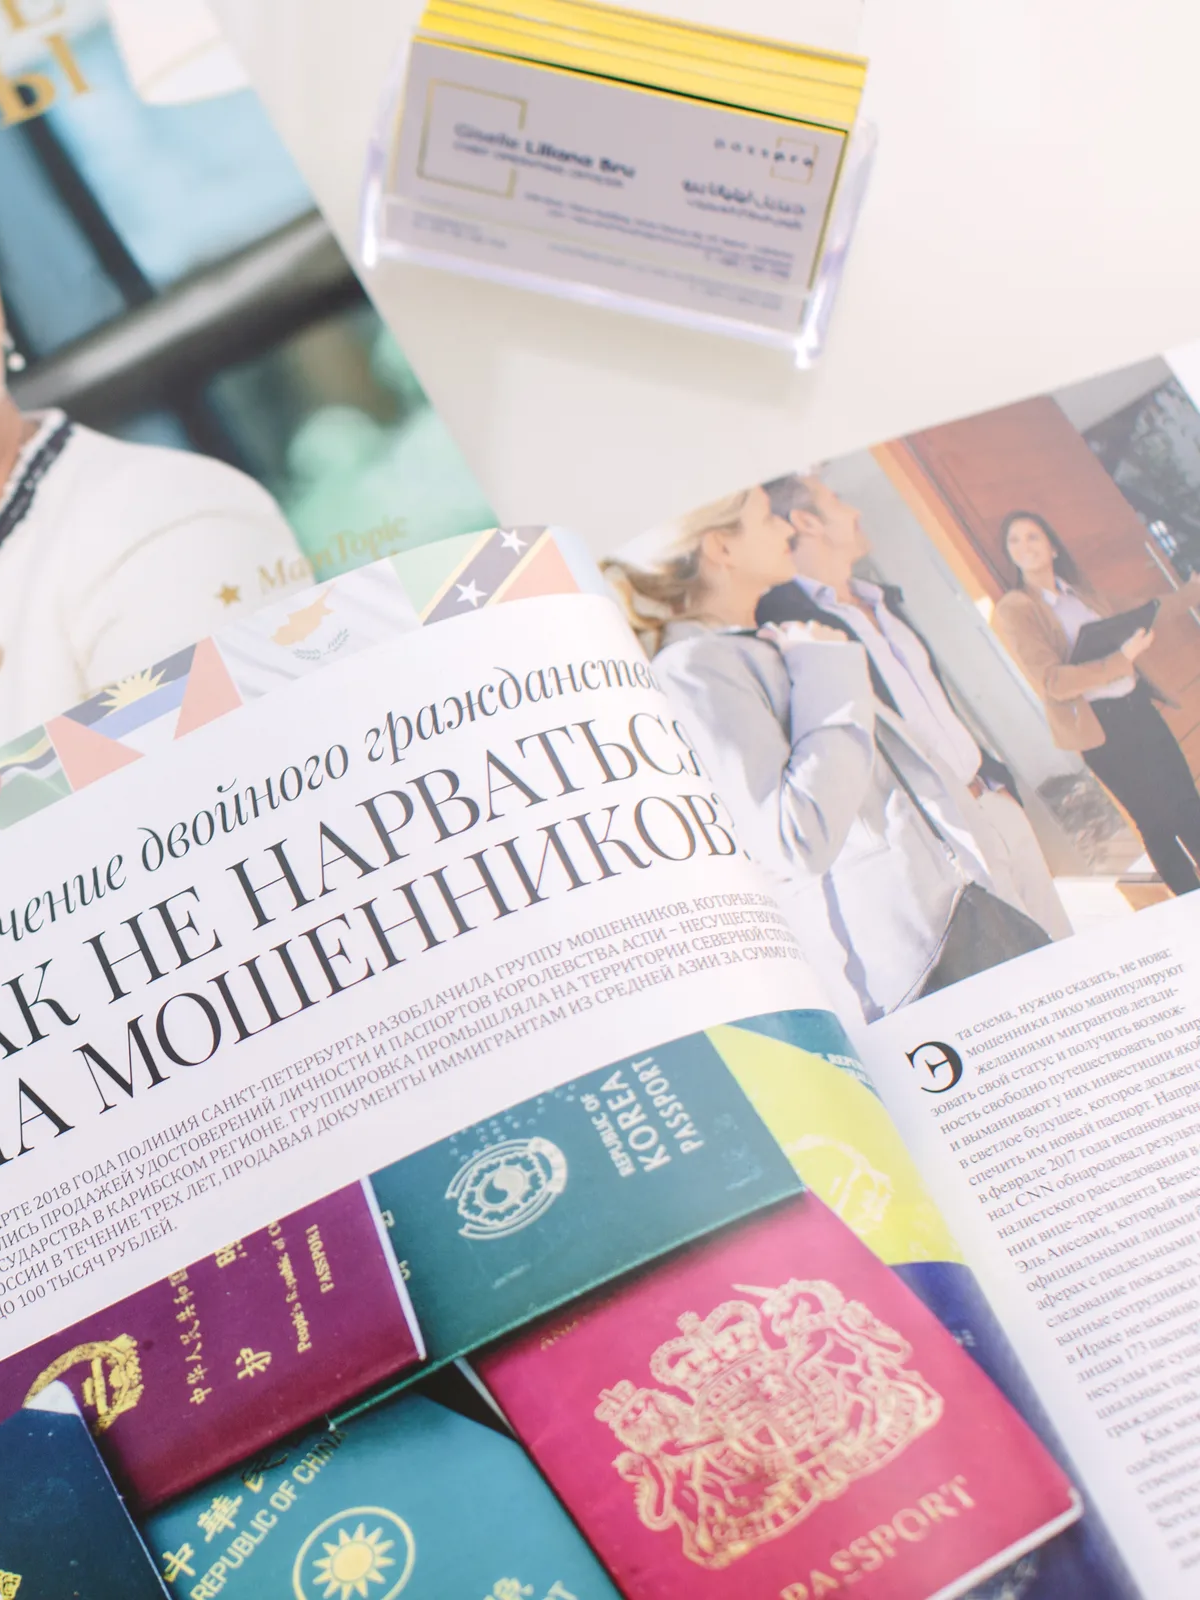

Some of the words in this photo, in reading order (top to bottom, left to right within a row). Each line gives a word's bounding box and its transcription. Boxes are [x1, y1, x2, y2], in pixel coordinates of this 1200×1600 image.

[137, 743, 350, 873] двойного
[82, 885, 224, 1005] НЕ
[32, 1181, 71, 1210] 2018
[72, 1159, 117, 1189] ГОДА
[117, 1114, 199, 1166] ПОЛИЦИЯ
[201, 1032, 366, 1122] САНКТ-ПЕТЕРБУРГА
[367, 972, 494, 1039] РАЗОБЛАЧИЛА
[495, 940, 562, 979] ГРУППУ
[566, 901, 693, 950] МОШЕННИКОВ,
[904, 1040, 963, 1094] Э
[954, 1028, 972, 1040] та
[972, 1010, 1018, 1033] схема,
[1017, 989, 1064, 1014] нужно
[1064, 970, 1119, 995] сказать,
[1119, 961, 1137, 974] не
[1136, 947, 1172, 967] нова:
[930, 1091, 976, 1117] зовать
[976, 1073, 1010, 1095] свой
[1010, 1055, 1055, 1080] статус
[1054, 1050, 1066, 1061] и
[1066, 1025, 1132, 1056] получить
[1131, 1005, 1185, 1030] возмож-
[965, 1016, 1049, 1057] мошенники
[1050, 1002, 1083, 1022] лихо
[1084, 963, 1183, 1007] манипулируют
[975, 1034, 1055, 1075] желаниями
[1056, 1005, 1129, 1039] мигрантов
[1130, 987, 1178, 1011] легали-
[40, 1168, 134, 1228] ПРОДАЖЕЙ
[135, 1096, 275, 1179] УДОСТОВЕРЕНИЙ
[279, 1051, 371, 1107] ЛИЧНОСТИ
[372, 1042, 387, 1059] И
[388, 994, 491, 1051] ПАСПОРТОВ
[493, 943, 624, 1002] КОРОЛЕВСТВА
[622, 927, 667, 952] АСПИ
[50, 1253, 63, 1268] В
[62, 1213, 140, 1260] ТЕЧЕНИЕ
[140, 1190, 183, 1220] ТРЕХ
[186, 1172, 221, 1200] ЛЕТ,
[221, 1124, 312, 1180] ПРОДАВАЯ
[316, 1069, 426, 1136] ДОКУМЕНТЫ
[427, 1006, 566, 1077] ИММИГРАНТАМ
[567, 995, 593, 1014] ИЗ
[594, 964, 674, 1004] СРЕДНЕЙ
[677, 953, 721, 976] АЗИИ
[719, 949, 743, 965] ЗА
[92, 1209, 104, 1224] В
[106, 1155, 207, 1217] КАРИБСКОМ
[209, 1116, 288, 1164] РЕГИОНЕ.
[289, 1054, 415, 1122] ГРУППИРОВКА
[415, 992, 550, 1060] ПРОМЫШЛЯЛА
[549, 980, 579, 1000] НА
[577, 941, 690, 987] ТЕРРИТОРИИ
[691, 925, 766, 950] СЕВЕРНОЙ
[580, 1092, 601, 1113] OF
[599, 1069, 673, 1173] KOREA
[631, 1055, 705, 1155] PASSPORT
[939, 1110, 981, 1134] ность
[981, 1080, 1047, 1114] свободно
[1047, 1037, 1156, 1085] путешествовать
[1155, 1029, 1174, 1042] по
[949, 1140, 961, 1152] и
[961, 1099, 1051, 1146] выманивают
[1051, 1094, 1061, 1108] у
[1062, 1082, 1091, 1100] них
[1090, 1050, 1174, 1089] инвестиции
[958, 1158, 969, 1169] в
[969, 1133, 1022, 1163] светлое
[1022, 1107, 1088, 1138] будущее,
[1087, 1083, 1143, 1111] которое
[1143, 1062, 1194, 1090] должен
[968, 1155, 1026, 1186] спечить
[1025, 1143, 1048, 1159] им
[1048, 1122, 1095, 1149] новый
[1094, 1100, 1154, 1129] паспорт.
[977, 1193, 988, 1203] в
[988, 1166, 1046, 1199] феврале
[1046, 1148, 1075, 1171] 2017
[1078, 1139, 1111, 1158] года
[986, 1202, 1015, 1221] нал
[1014, 1181, 1054, 1207] CNN
[1055, 1146, 1145, 1189] обнародовал
[996, 1193, 1085, 1238] налистского
[1086, 1150, 1188, 1200] расследования
[1188, 1145, 1199, 1156] в
[17, 1284, 45, 1307] 100
[46, 1253, 105, 1291] ТЫСЯЧ
[106, 1216, 177, 1262] РУБЛЕЙ.
[189, 1508, 279, 1600] REPUBLIC
[269, 1479, 298, 1513] OF
[780, 1473, 976, 1600] PASSPORT
